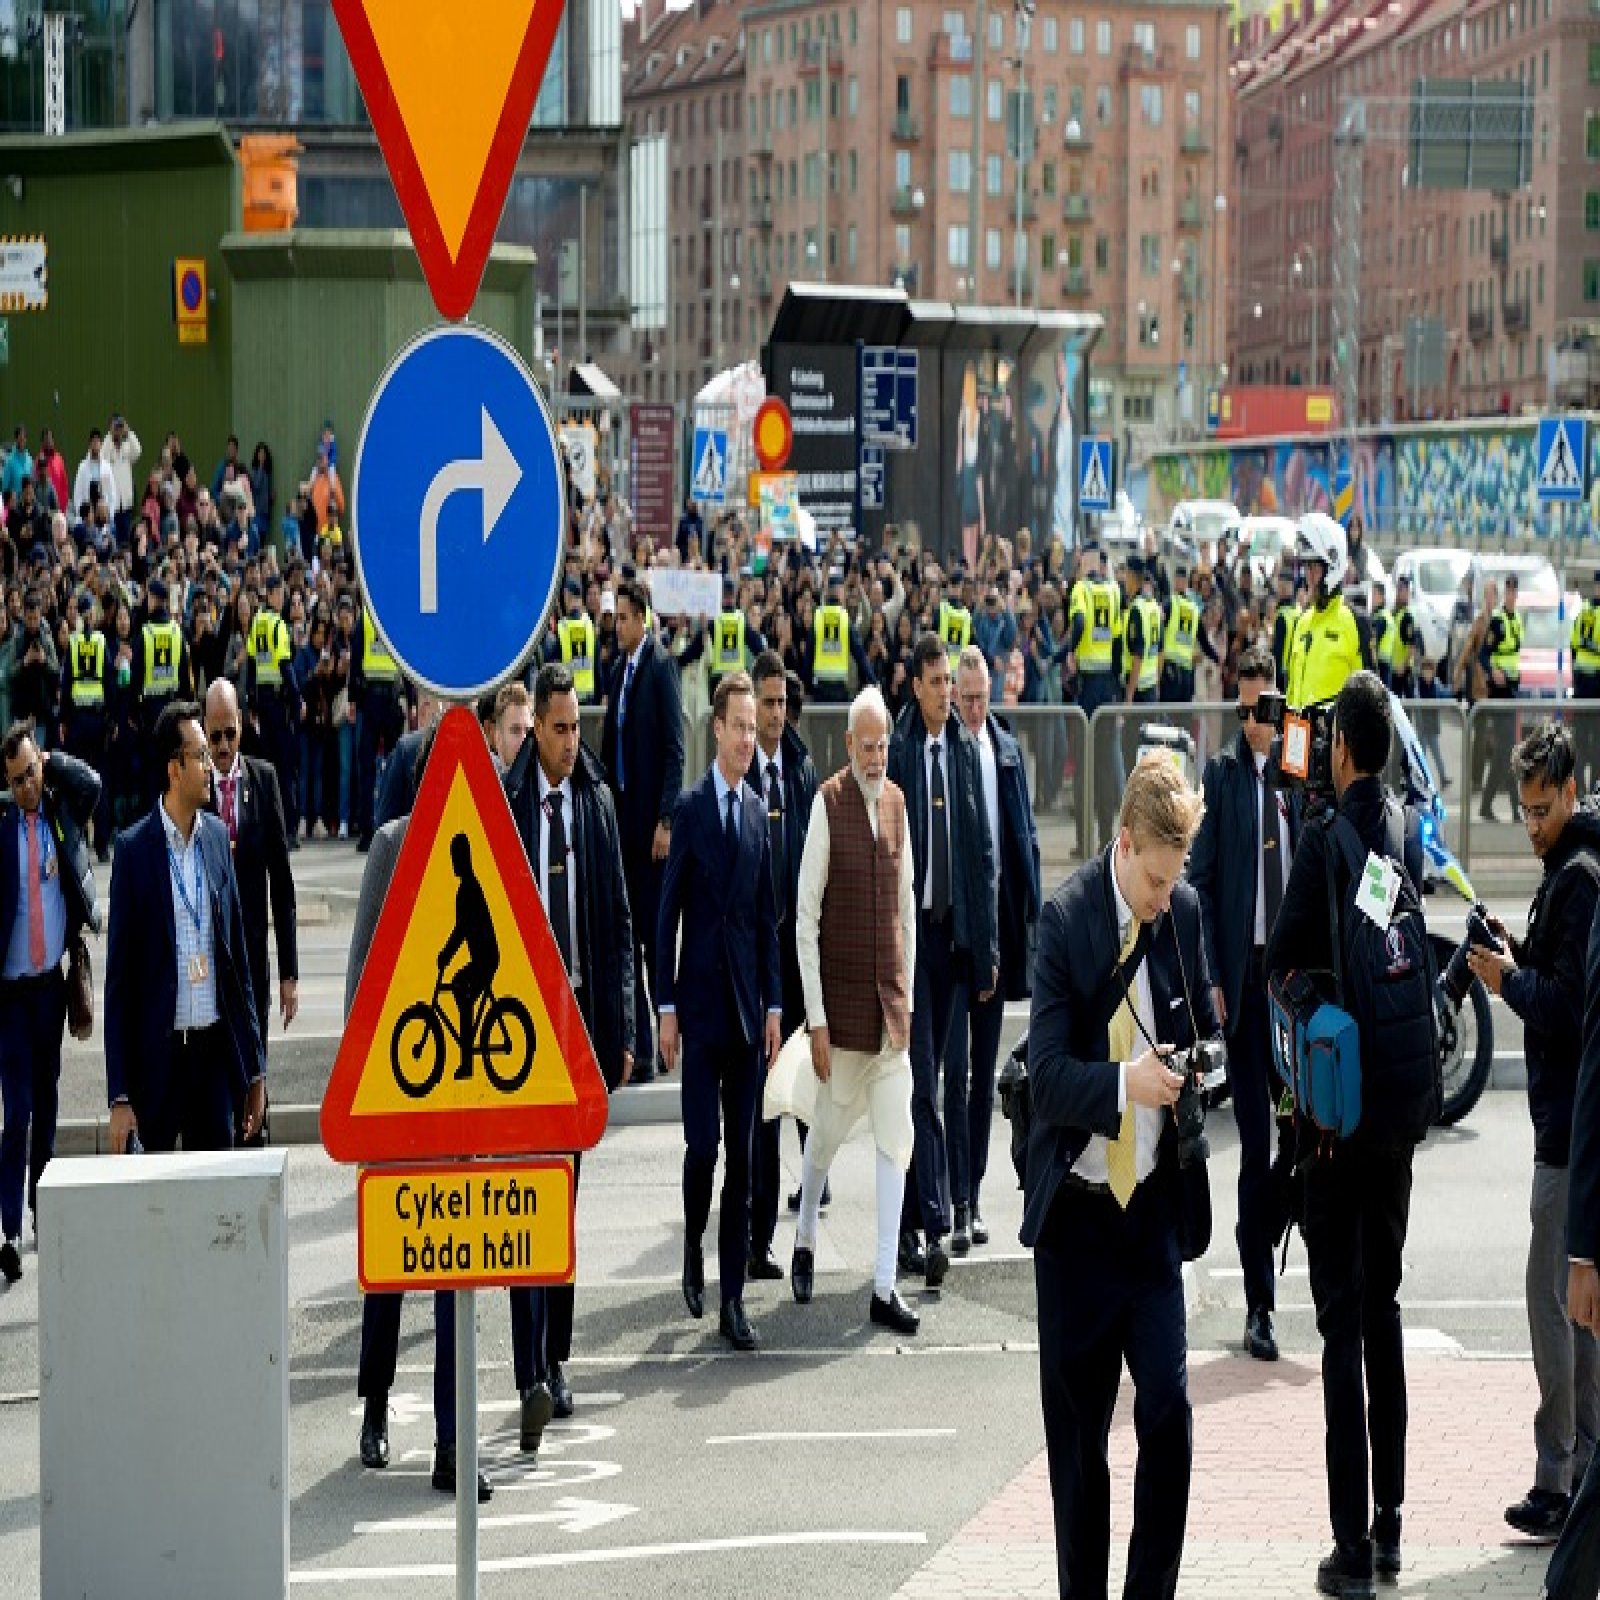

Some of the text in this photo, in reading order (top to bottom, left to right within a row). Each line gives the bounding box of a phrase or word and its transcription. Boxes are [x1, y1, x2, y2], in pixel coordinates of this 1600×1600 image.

[395, 1176, 537, 1230] Cykel från
[403, 1229, 531, 1273] båda håll
